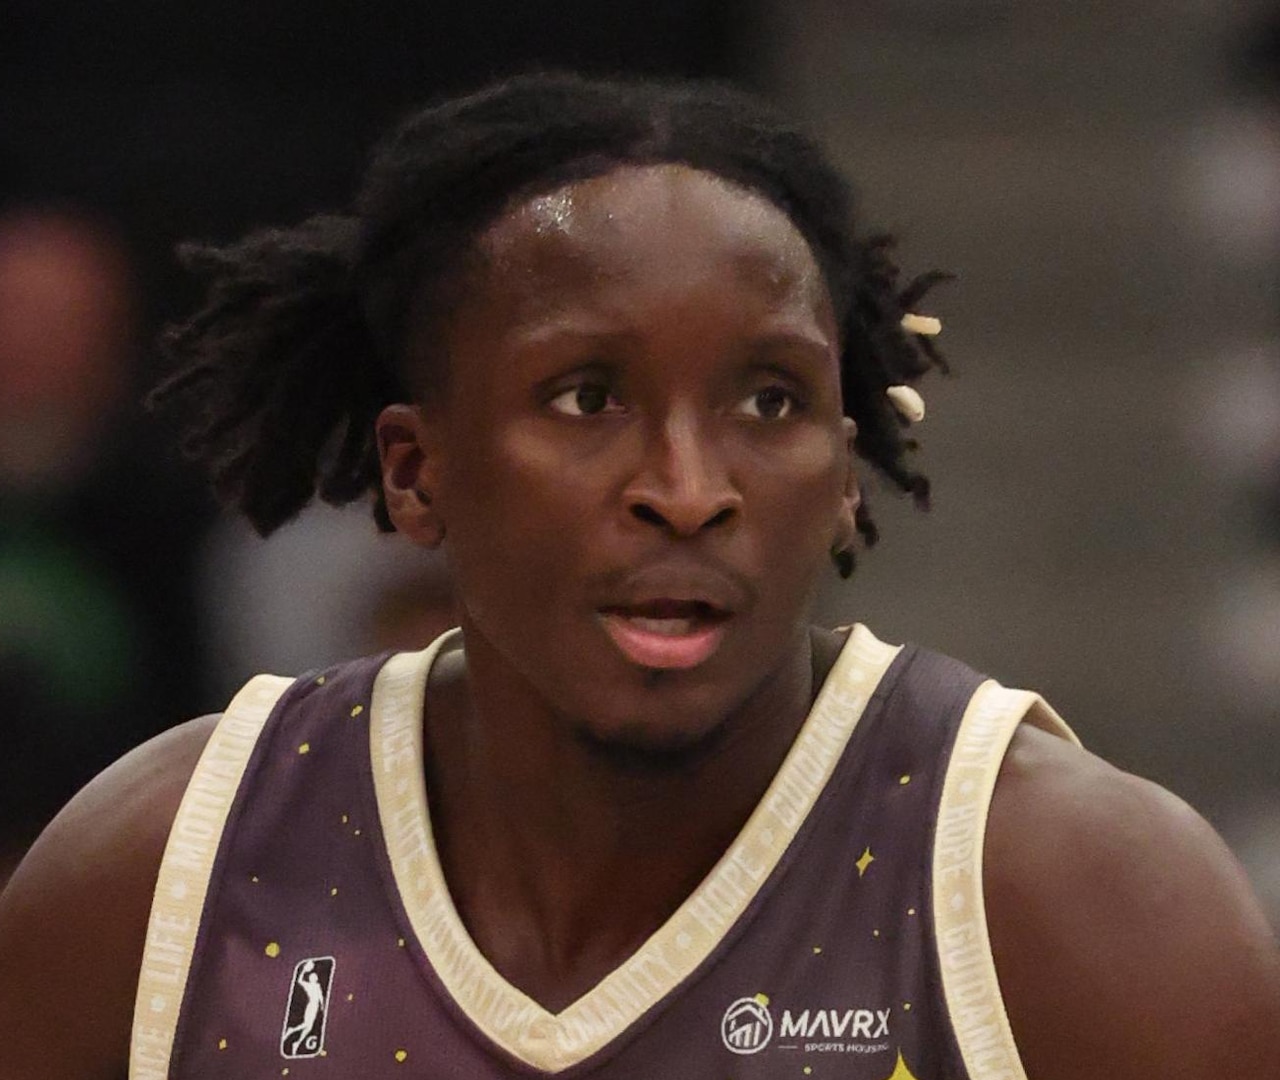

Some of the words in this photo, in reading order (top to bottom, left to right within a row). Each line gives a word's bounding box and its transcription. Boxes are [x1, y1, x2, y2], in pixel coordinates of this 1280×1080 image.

[686, 846, 765, 936] HOPE
[766, 682, 860, 830] GUIDANCE
[147, 911, 191, 984] LIFE
[779, 1008, 891, 1038] MAVRX
[305, 1035, 318, 1050] G
[804, 1042, 845, 1053] SPORTS
